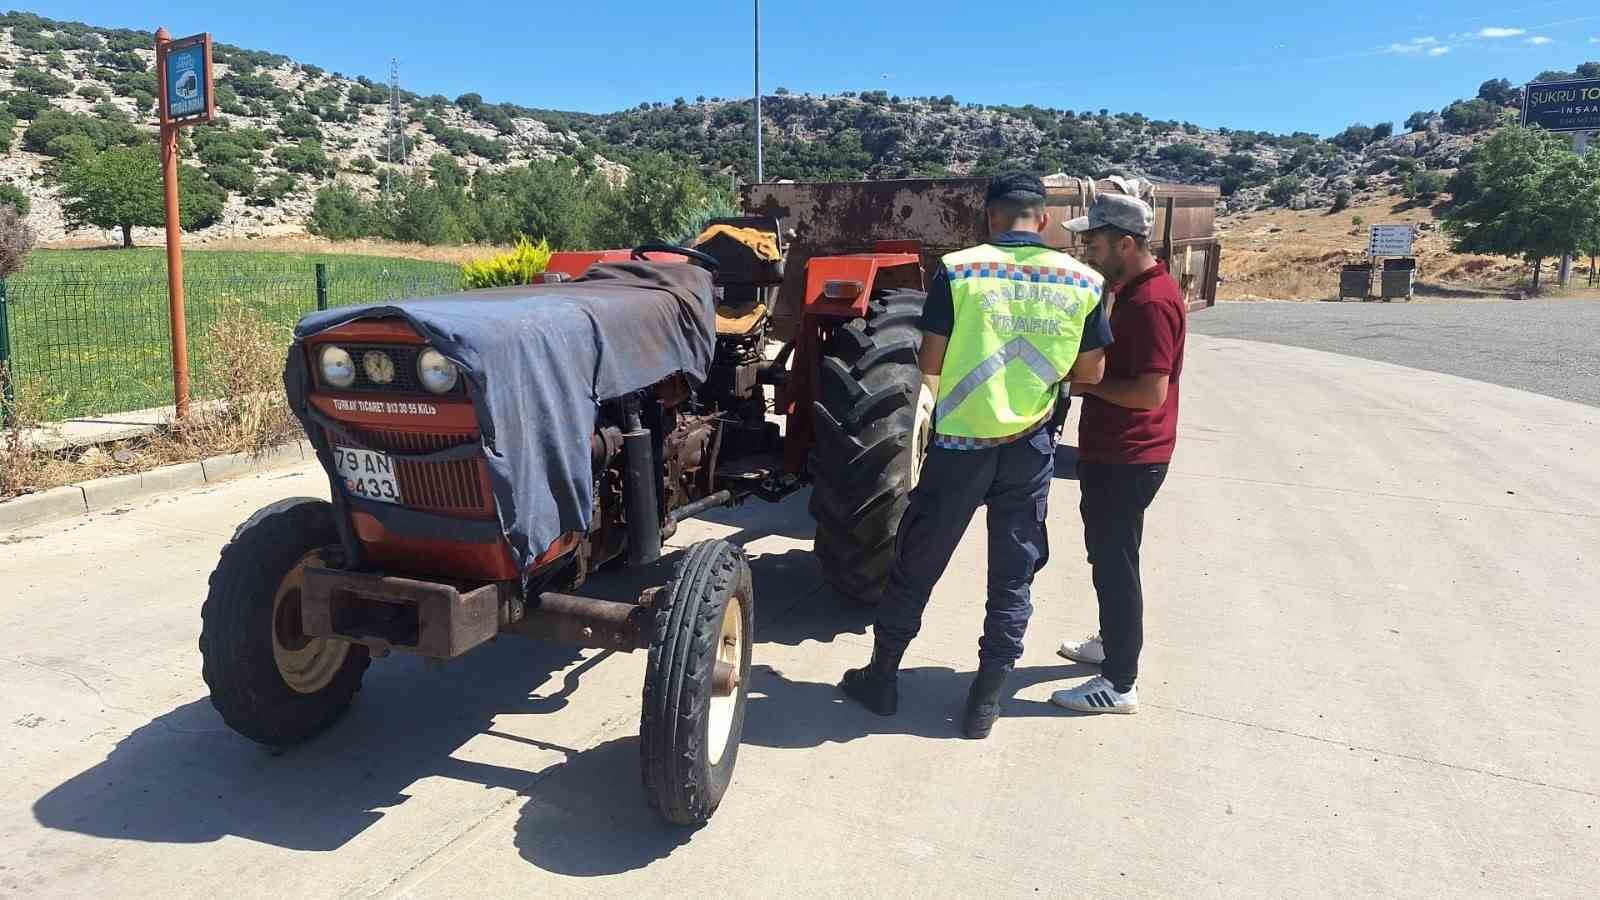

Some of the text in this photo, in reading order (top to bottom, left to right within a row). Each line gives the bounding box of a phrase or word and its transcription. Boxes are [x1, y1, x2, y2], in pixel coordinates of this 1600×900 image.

[336, 449, 391, 474] 79 AN
[356, 477, 395, 498] 433
